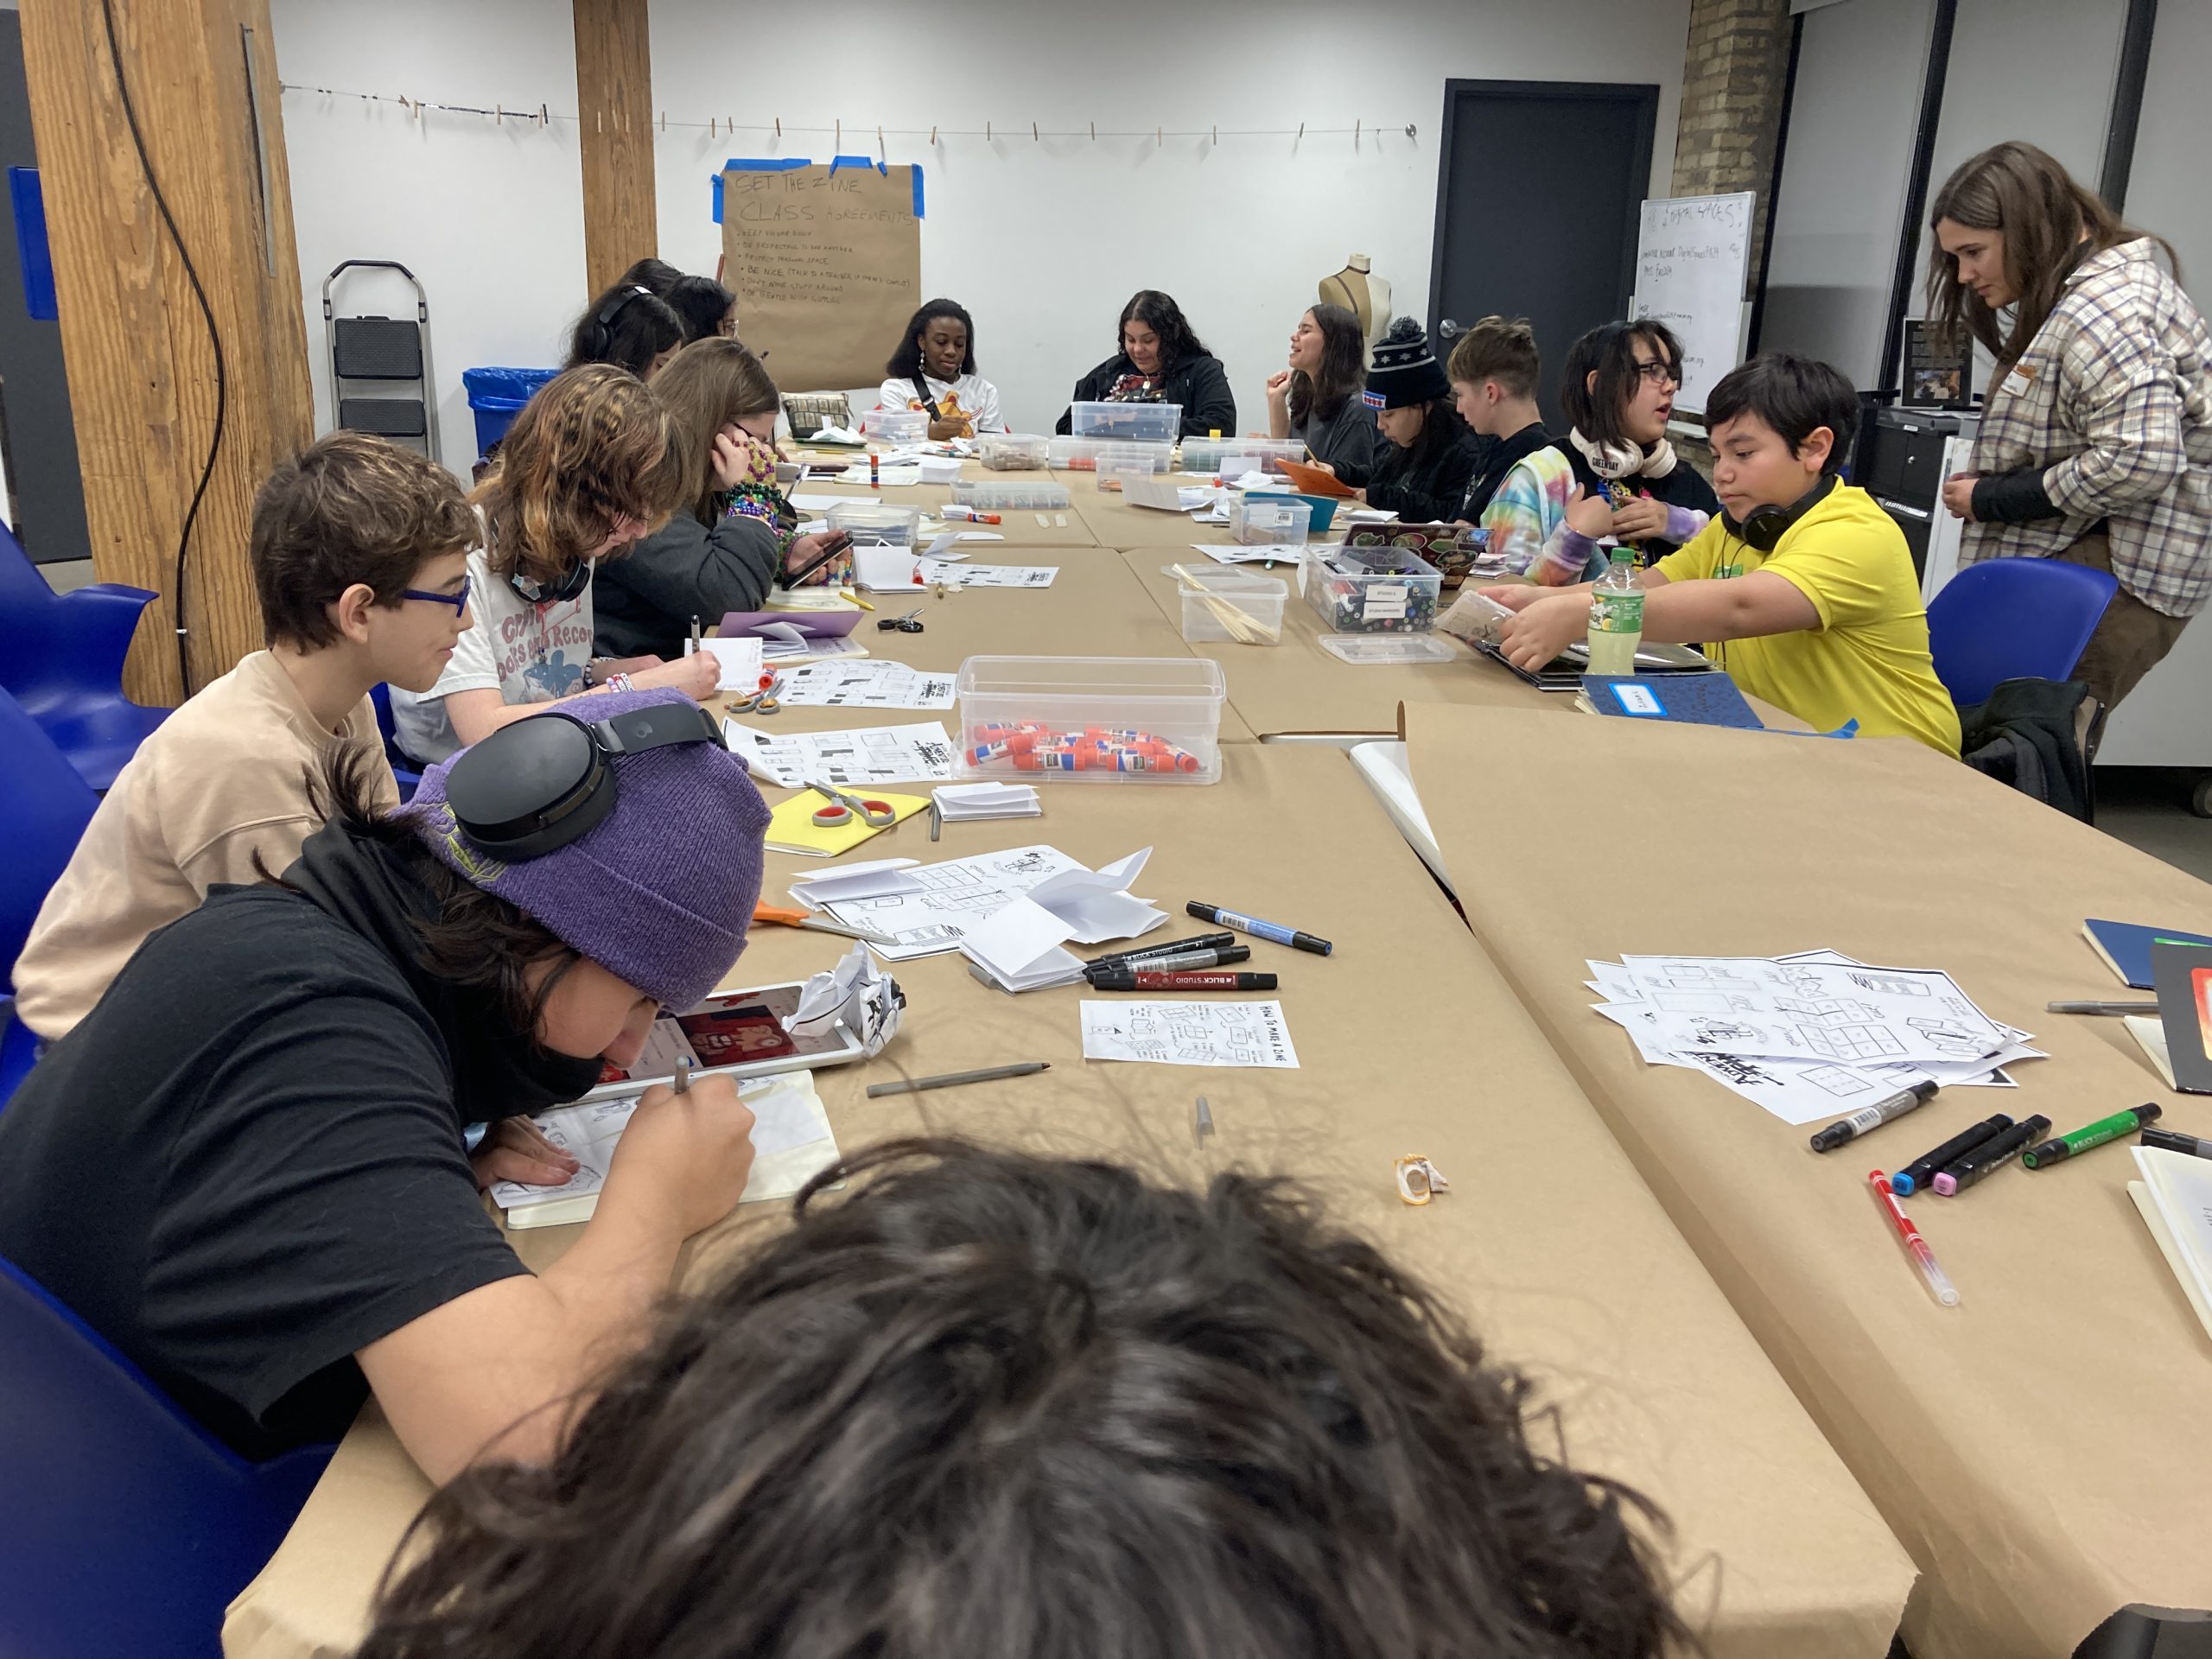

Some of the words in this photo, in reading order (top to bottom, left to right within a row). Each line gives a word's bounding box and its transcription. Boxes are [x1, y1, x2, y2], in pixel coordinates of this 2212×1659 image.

[783, 173, 805, 193] THE
[813, 177, 862, 194] ZINE
[740, 201, 815, 222] CLASS
[826, 206, 913, 226] AGREEMENTS
[747, 264, 760, 274] BE
[764, 268, 784, 276] NICE
[815, 283, 843, 292] AROUND
[1607, 461, 1619, 471] DAY
[1131, 951, 1150, 961] BLICK
[1152, 948, 1173, 957] STUDIO
[1259, 1005, 1274, 1017] HOW
[1267, 1027, 1281, 1041] MAKE
[1273, 1049, 1287, 1061] ZINE
[2078, 1137, 2094, 1148] BLICK
